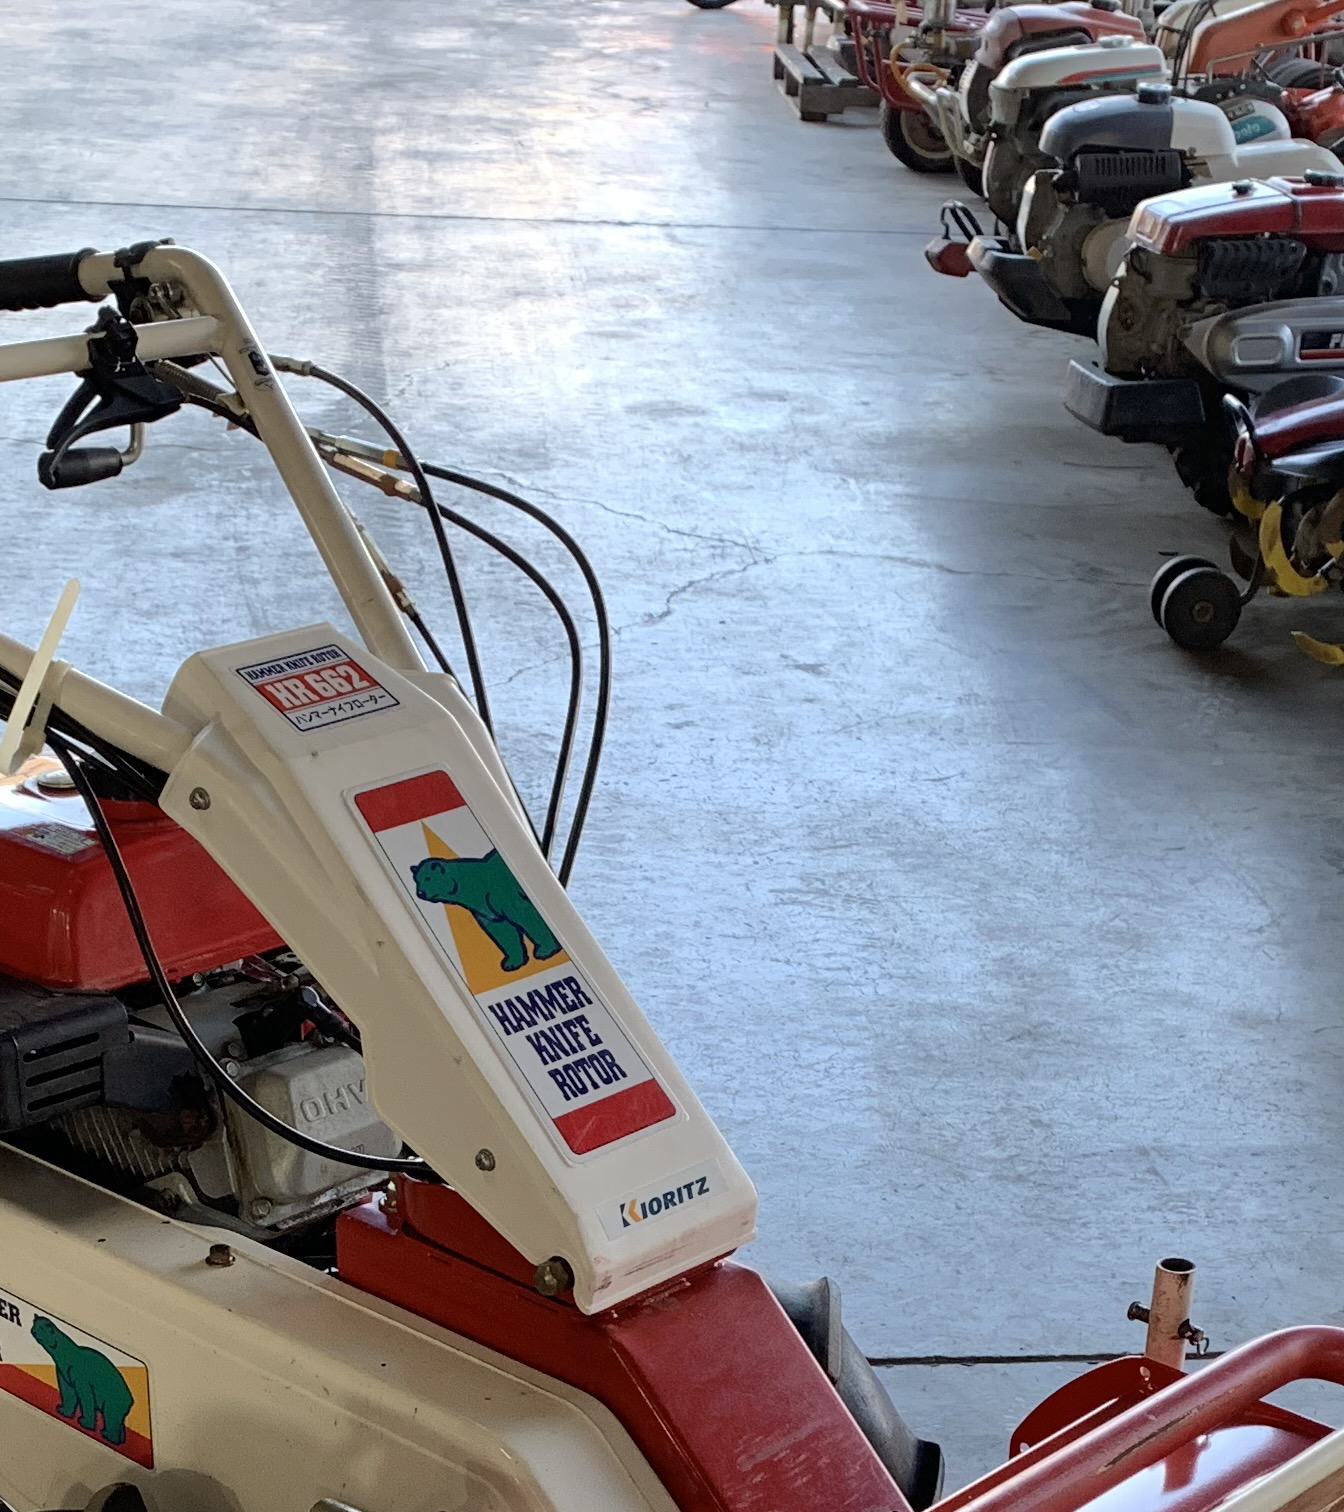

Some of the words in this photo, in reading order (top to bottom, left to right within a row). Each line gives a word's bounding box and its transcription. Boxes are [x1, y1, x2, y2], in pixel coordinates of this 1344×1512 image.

[244, 663, 287, 681] HAMMER
[286, 656, 314, 671] KNIFE
[311, 649, 343, 663] ROTOR
[488, 976, 594, 1036] HAMMER
[525, 1014, 603, 1066] KNIFE
[548, 1049, 628, 1101] ROTOR
[620, 1176, 710, 1228] KIORITZ
